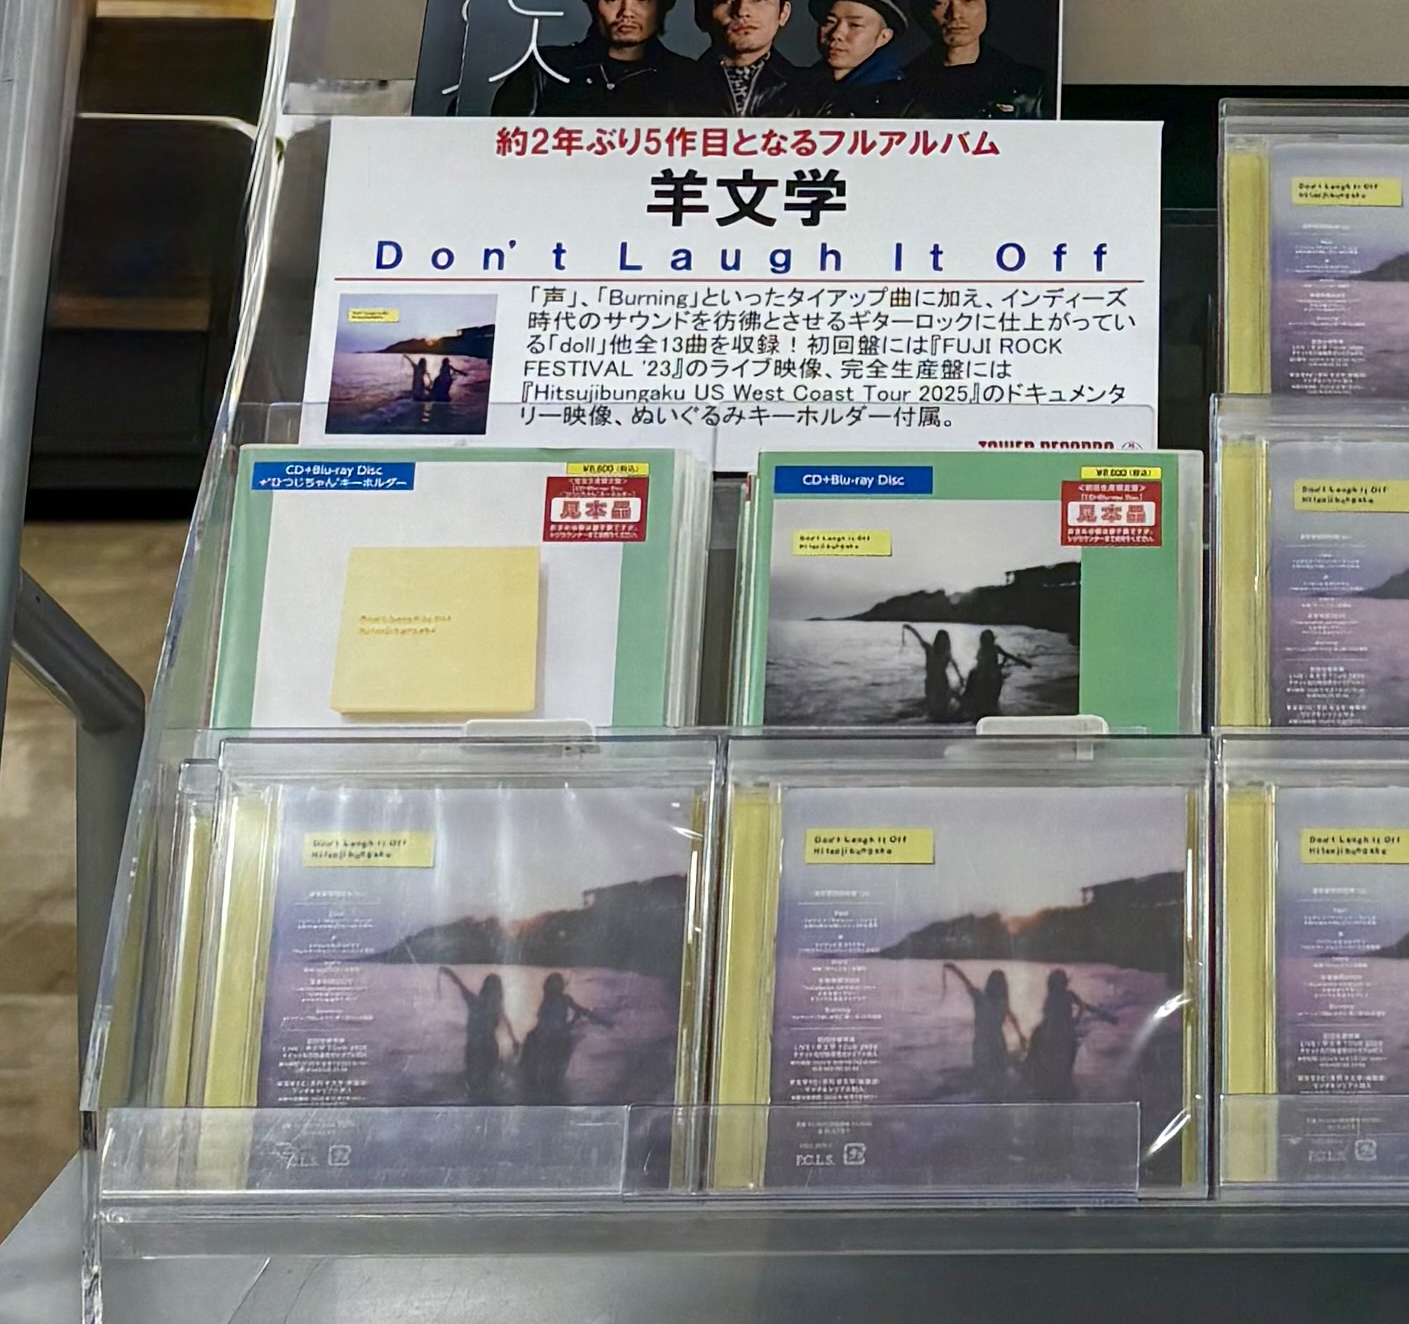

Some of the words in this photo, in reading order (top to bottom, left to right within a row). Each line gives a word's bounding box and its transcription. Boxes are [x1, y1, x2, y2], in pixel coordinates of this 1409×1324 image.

[496, 127, 1000, 158] 約2年ぶり5作目となるフルアルバム
[647, 168, 848, 227] 羊文学
[619, 242, 843, 274] Laugh
[894, 243, 944, 271] It
[996, 243, 1111, 271] Off
[1000, 337, 1062, 355] ROCK
[524, 360, 632, 377] FESTIVAL
[695, 384, 724, 401] US
[733, 384, 784, 401] West
[793, 384, 854, 401] Coast
[865, 385, 911, 402] Tour
[521, 406, 953, 427] リー映像、ぬいぐるみキーホルダー付属。
[878, 475, 904, 486] Disc
